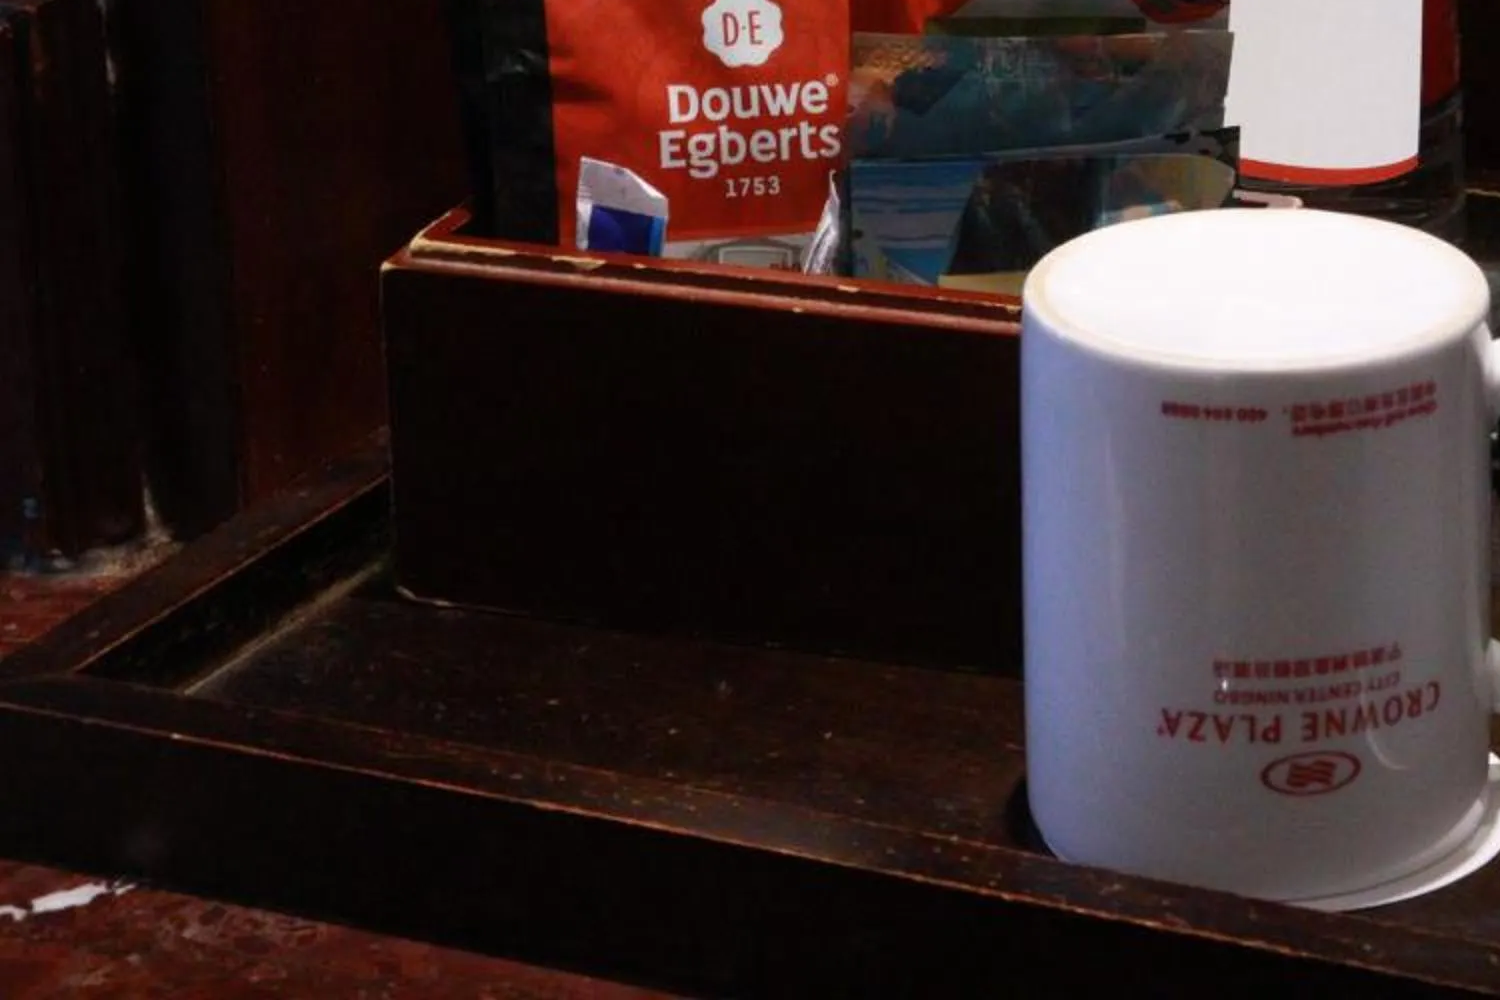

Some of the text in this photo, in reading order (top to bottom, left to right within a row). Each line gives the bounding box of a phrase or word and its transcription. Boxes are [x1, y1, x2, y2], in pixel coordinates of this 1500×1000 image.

[658, 120, 841, 179] Egberts
[725, 176, 781, 198] 1753
[1301, 680, 1441, 743] CROWNE
